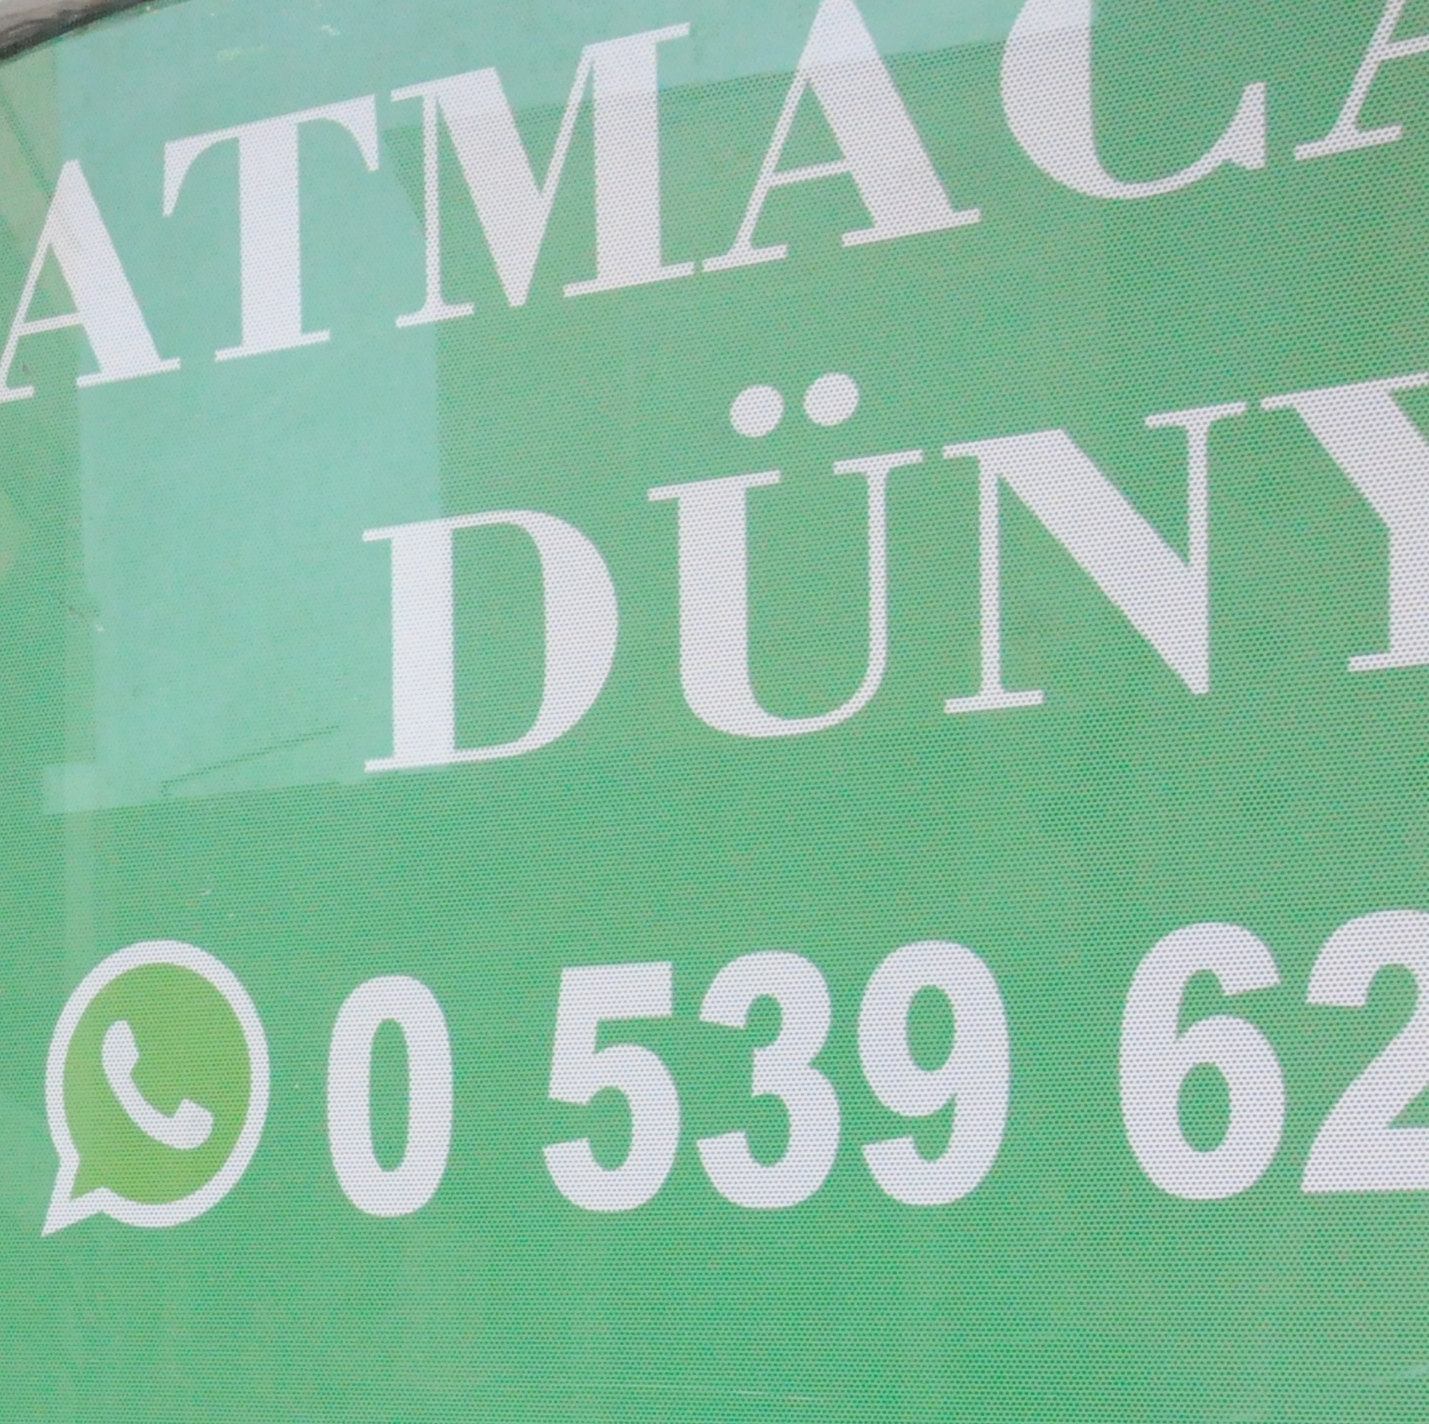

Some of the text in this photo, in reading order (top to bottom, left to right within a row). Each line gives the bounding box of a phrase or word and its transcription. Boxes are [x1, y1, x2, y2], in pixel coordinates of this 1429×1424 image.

[326, 908, 1429, 1218] 0 539 62
